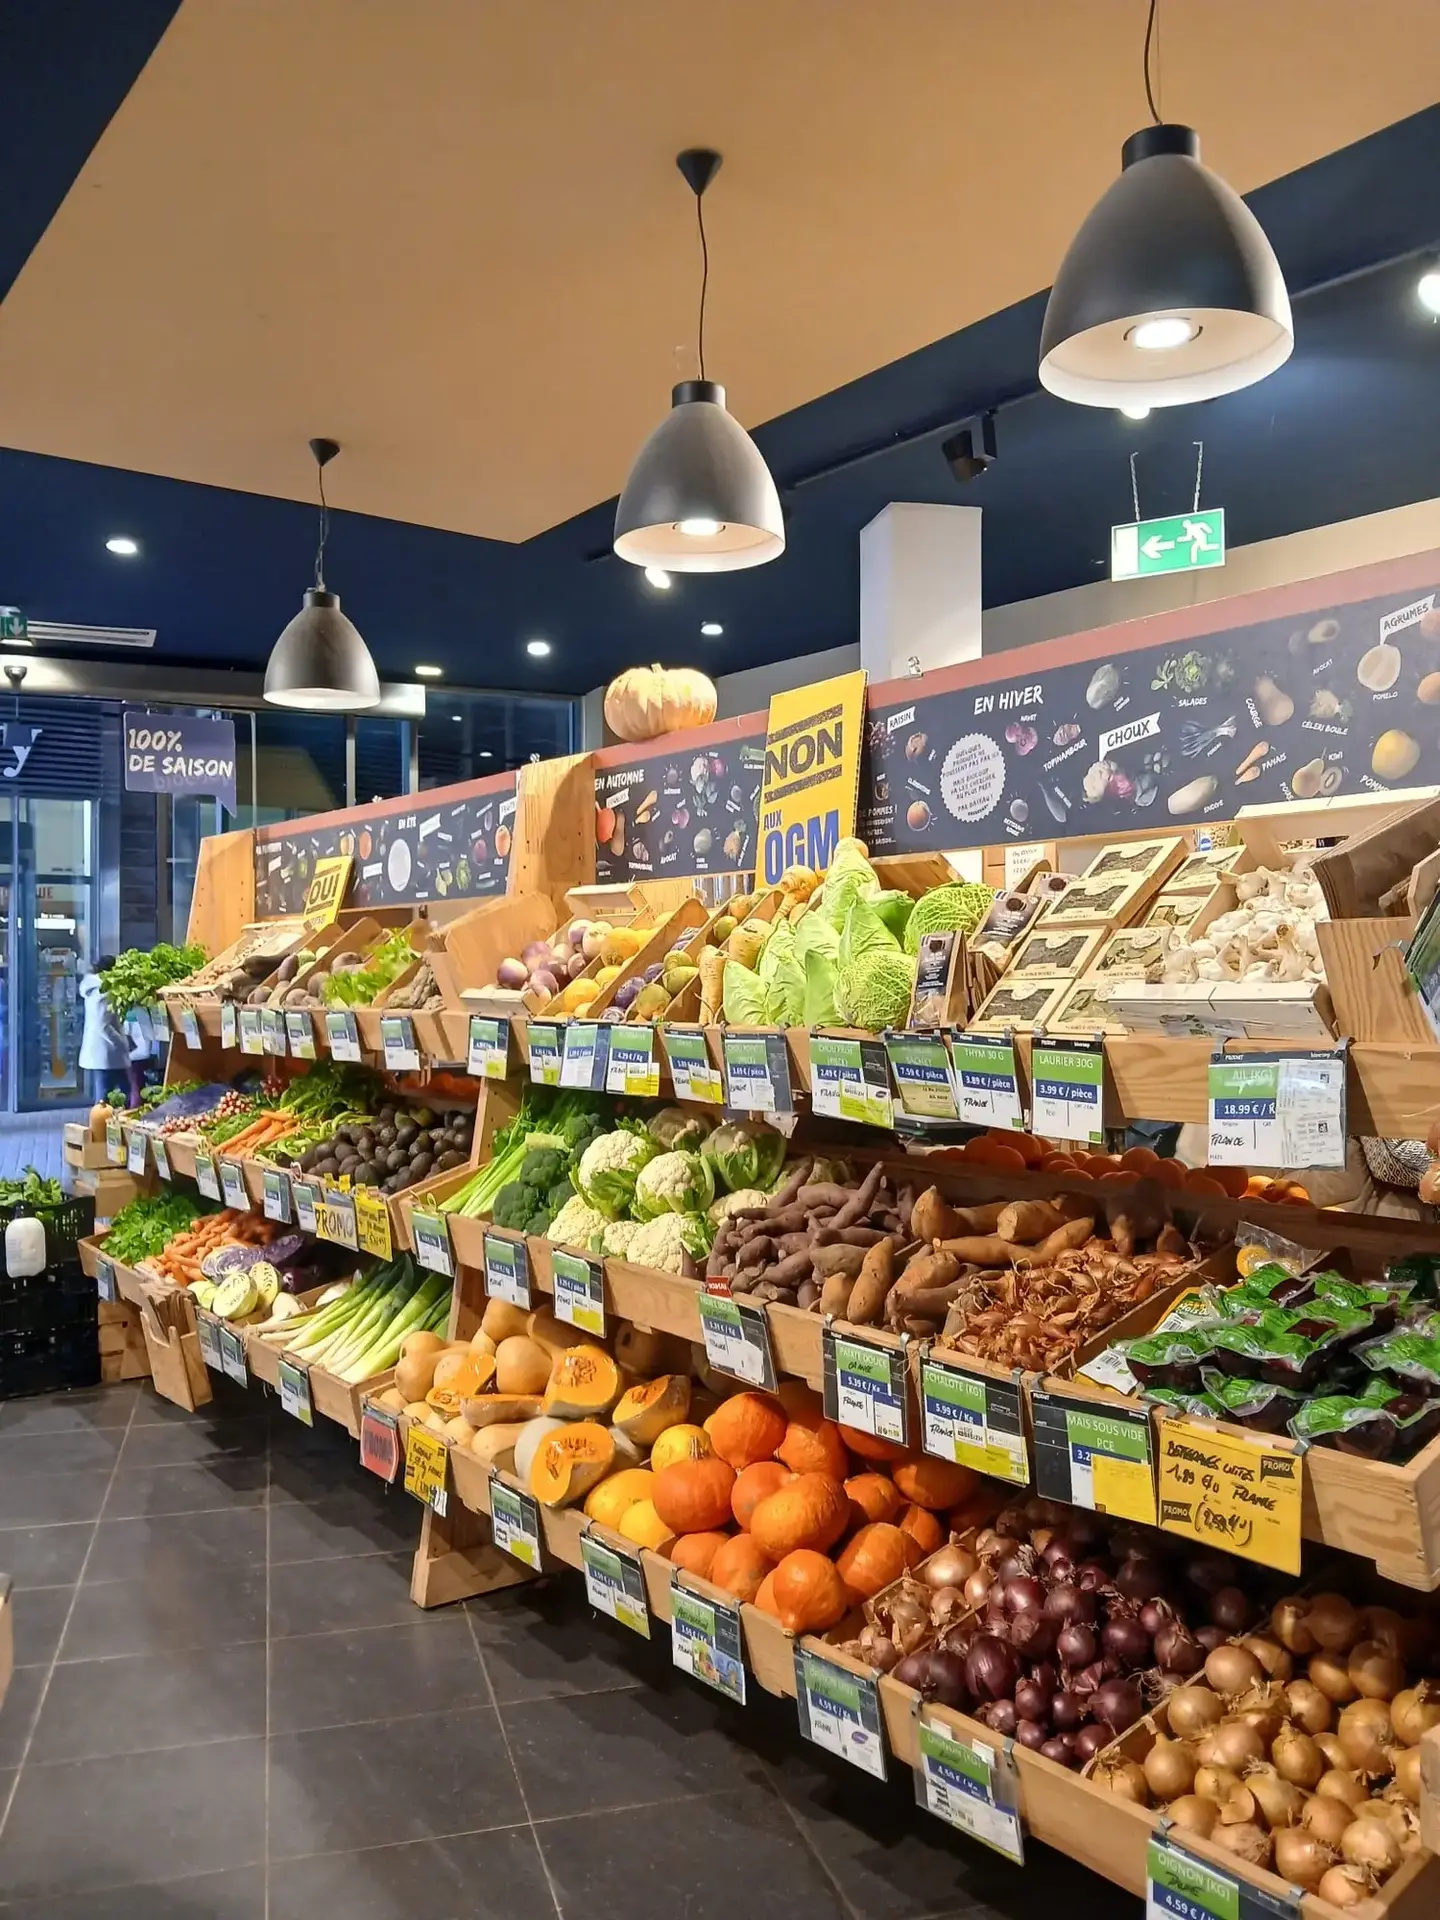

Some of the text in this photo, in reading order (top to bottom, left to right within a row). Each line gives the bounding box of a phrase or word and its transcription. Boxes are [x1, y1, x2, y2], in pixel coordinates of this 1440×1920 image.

[1383, 603, 1429, 631] AGRUMES
[1312, 658, 1333, 676] AVOCAT
[973, 684, 1044, 716] EN HIVER
[1177, 697, 1208, 708] SALADES
[1372, 691, 1398, 701] POMELO
[1245, 698, 1263, 729] COURGE
[129, 728, 182, 752] 100%
[1107, 720, 1150, 748] CHOUX
[1325, 724, 1349, 736] BOULE
[764, 722, 843, 786] NON
[1043, 738, 1088, 772] TOPINAMBOUR
[1262, 753, 1287, 771] PANAIS
[129, 754, 234, 777] DE SAISON
[606, 769, 645, 789] AUTOMNE
[763, 809, 782, 831] AUX
[764, 809, 840, 886] OGM
[309, 873, 340, 905] OUI
[964, 1048, 985, 1059] THYM
[998, 1052, 1004, 1061] G
[1039, 1055, 1093, 1069] LAURIER 30G
[965, 1075, 980, 1085] 3.89
[981, 1077, 987, 1086] €
[991, 1077, 1011, 1090] pièce
[1040, 1084, 1057, 1095] 3.99
[1058, 1086, 1064, 1096] €
[1071, 1087, 1093, 1101] pièce
[1224, 1104, 1250, 1115] 18.99
[1252, 1104, 1259, 1114] €
[315, 1208, 354, 1238] PROMO
[935, 1402, 951, 1416] 5.99
[952, 1409, 957, 1418] €
[1068, 1415, 1144, 1442] MAIS SOUS VIDE
[1077, 1449, 1091, 1461] 3.2
[1096, 1437, 1115, 1452] PCE
[1262, 1459, 1291, 1472] PROMO
[1232, 1485, 1278, 1511] FRANCE
[1163, 1505, 1189, 1517] PROMO
[1158, 1852, 1204, 1885] OIGNON
[1165, 1895, 1188, 1914] 4.59
[1190, 1908, 1197, 1919] €
